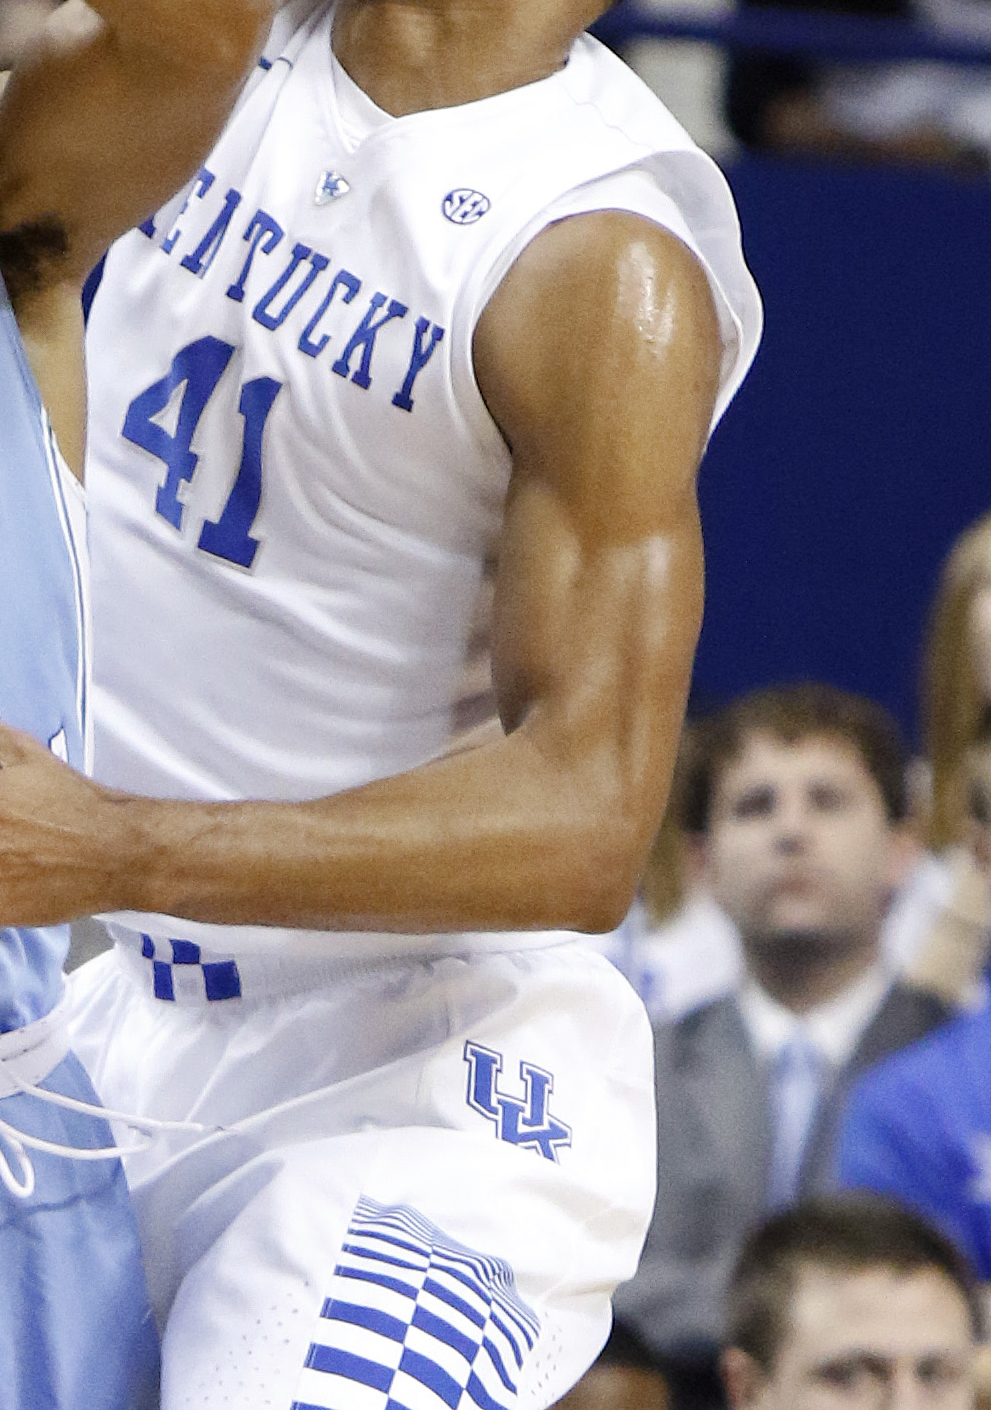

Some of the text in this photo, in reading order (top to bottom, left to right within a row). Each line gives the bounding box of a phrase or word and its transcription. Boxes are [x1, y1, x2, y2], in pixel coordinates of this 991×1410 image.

[138, 166, 446, 413] ENTUCKY
[442, 188, 491, 225] SEC
[120, 334, 283, 570] 41
[463, 1039, 573, 1166] UK
